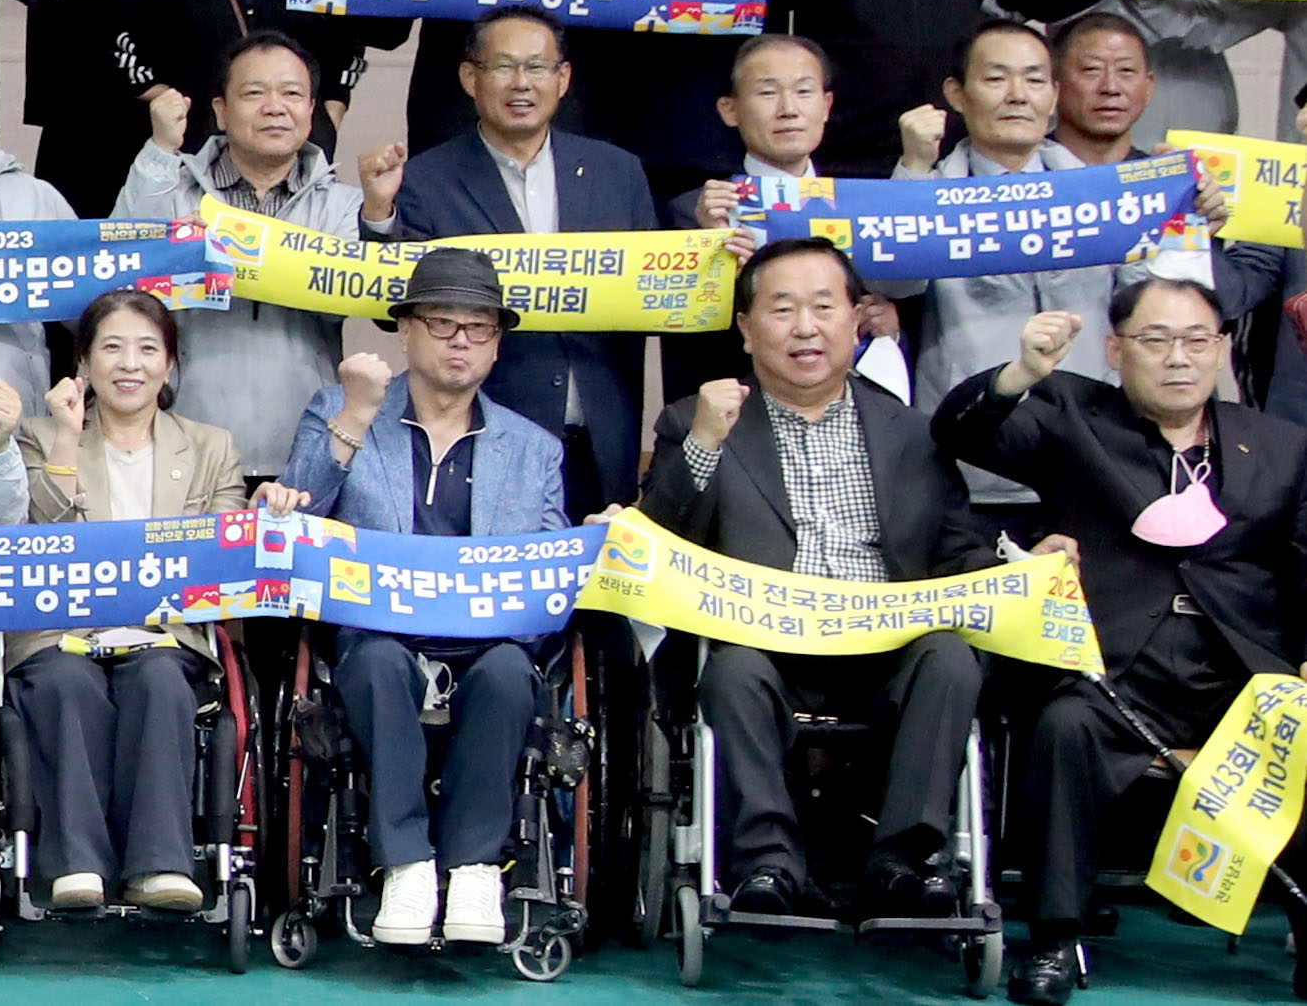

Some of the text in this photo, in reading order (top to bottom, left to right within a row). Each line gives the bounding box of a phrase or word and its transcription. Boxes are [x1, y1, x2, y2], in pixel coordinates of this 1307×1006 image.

[1255, 158, 1307, 188] 제4
[936, 182, 1053, 205] 2022-2023
[858, 192, 1166, 261] 전라남도 방문의 해
[279, 231, 367, 262] 제43회
[643, 252, 699, 270] 2023
[94, 250, 144, 280] 해
[638, 274, 698, 290] 전남으로
[642, 293, 687, 309] 오세요
[459, 538, 584, 563] 2022-2023
[23, 560, 130, 616] 방문의
[138, 553, 187, 587] 해
[377, 562, 525, 617] 전라남도
[598, 576, 643, 596] 전라남도
[669, 549, 1029, 613] 제43회 전국장애인체육대회
[698, 591, 994, 638] 제104회 전국체육대회
[1040, 621, 1085, 644] 오세요
